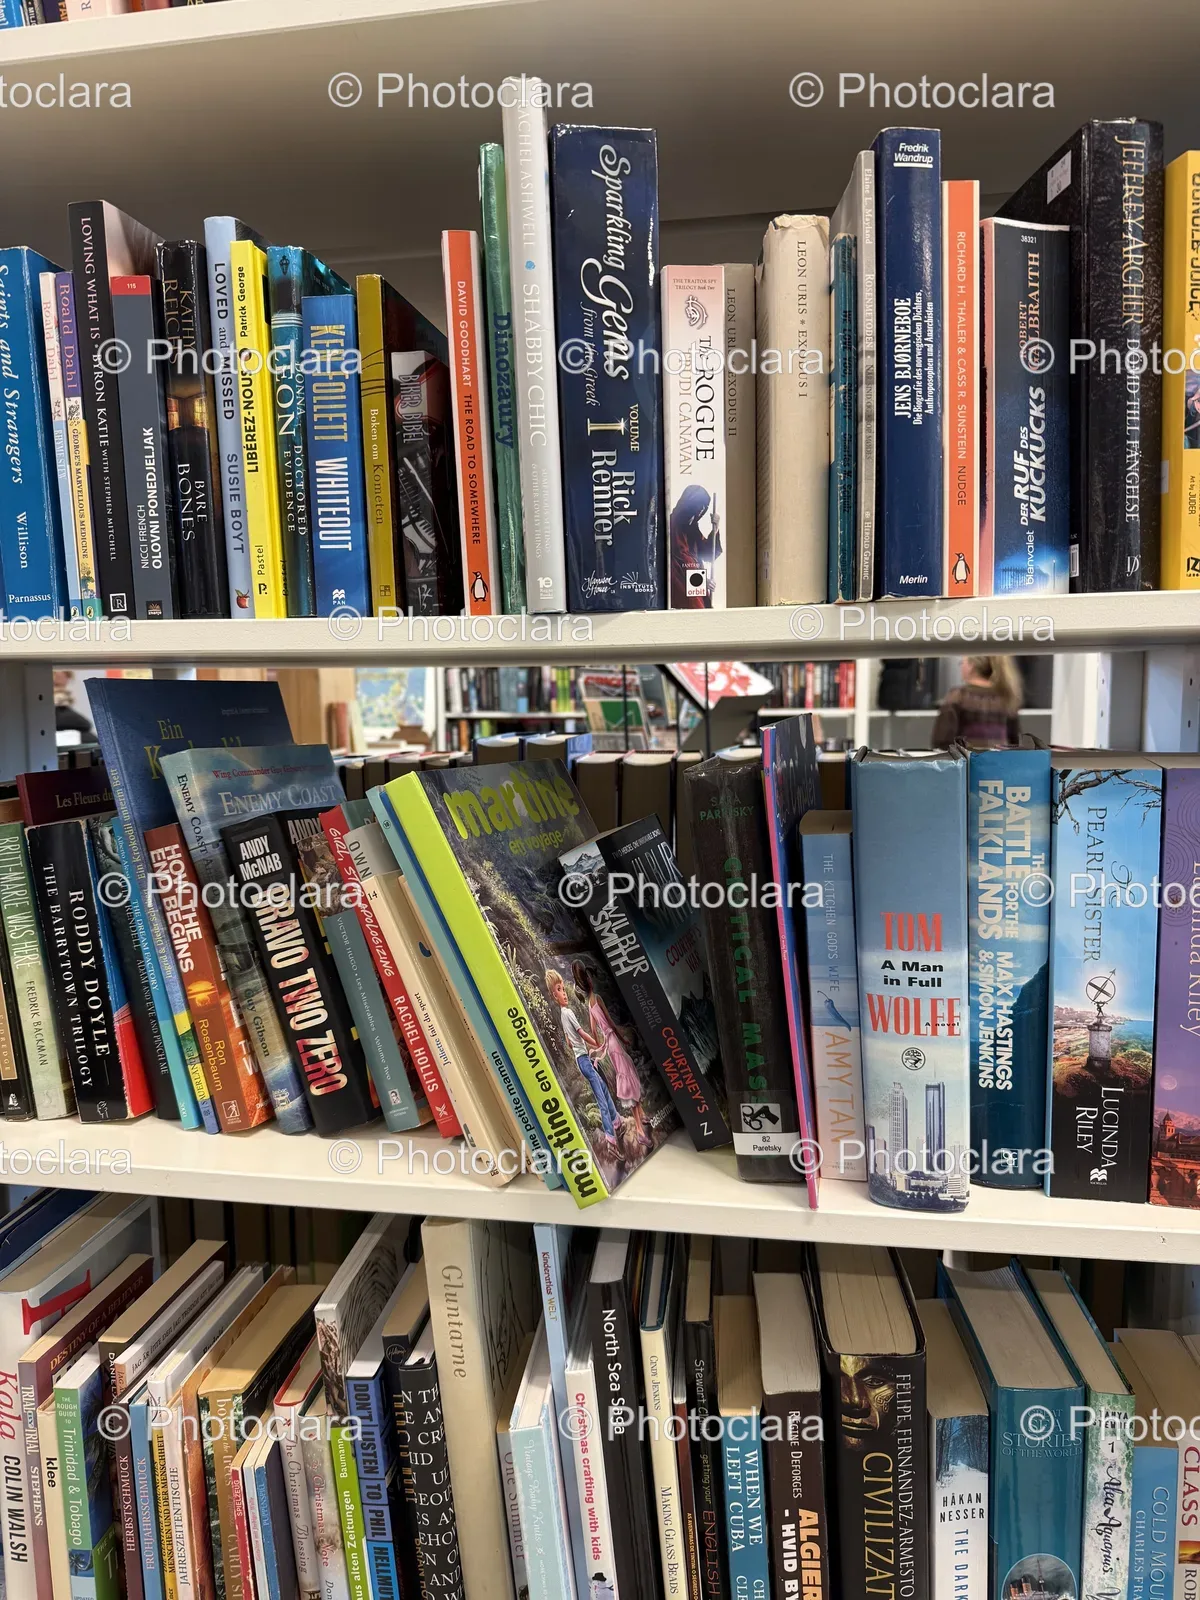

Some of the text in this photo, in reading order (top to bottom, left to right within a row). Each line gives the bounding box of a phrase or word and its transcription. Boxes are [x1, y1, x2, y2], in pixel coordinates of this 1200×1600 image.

[894, 153, 933, 164] Wandrup
[899, 143, 929, 153] Fredrik
[591, 144, 632, 272] Sparkling
[1020, 235, 1037, 243] 38321
[1115, 135, 1148, 328] JEFFREY ARCHER
[127, 282, 136, 290] 115
[214, 263, 229, 320] LOVED
[796, 240, 808, 316] LEON URIS
[59, 283, 77, 388] Roald Dahl
[523, 283, 543, 380] SHABBY
[894, 298, 912, 419] JENS BJØRNEBOE
[956, 231, 967, 505] RICHARD THALER SUNSTEIN NUDGE
[81, 217, 116, 561] LOVING WHAT KATIE MITCHELL
[457, 280, 480, 545] DAVID GOODHART THE ROAD TO SOMEWHERE
[493, 311, 513, 449] Dinozaury
[527, 386, 547, 447] CHIC
[4, 388, 22, 485] Strangers
[629, 403, 640, 452] VOLUME
[679, 402, 693, 476] CANAVAN
[1029, 385, 1045, 522] KUCKUCKS
[142, 427, 162, 569] OLOVNI PONEDJELJAK
[177, 463, 195, 541] BONES
[194, 480, 207, 523] BARE
[227, 453, 244, 553] SUSIE BOYT
[315, 456, 352, 551] WHITEOUT
[592, 449, 617, 547] Renner
[612, 470, 637, 525] Rick
[1013, 450, 1030, 499] RUF
[16, 511, 28, 569] Willison
[137, 504, 147, 543] FRENCH
[257, 545, 265, 576] Pastel
[1025, 530, 1034, 586] blanvalet
[8, 592, 51, 604] Parnassus
[899, 574, 928, 585] Merlin
[157, 718, 184, 741] Ein
[177, 773, 195, 814] ENEMY
[218, 783, 337, 817] ENEMY COAST
[443, 766, 580, 840] martine
[239, 835, 270, 861] ANDY
[239, 852, 283, 882] McNAB
[823, 854, 834, 874] THE
[977, 780, 1004, 941] FALKLANDS
[1005, 786, 1031, 938] BATTLE THE
[162, 895, 194, 974] BEGINS
[880, 911, 944, 953] TOM
[881, 960, 945, 973] A Man
[43, 863, 93, 1088] THE BARRYTOWN TRILOGY
[69, 889, 111, 1057] RODDY DOYLE
[883, 974, 943, 989] in Full
[26, 980, 48, 1066] FREDRIK BACKMAN
[214, 1039, 227, 1066] Ron
[278, 967, 348, 1097] TWO ZERO
[393, 994, 440, 1094] RACHEL HOLLIS
[507, 1007, 541, 1069] voyage
[866, 993, 961, 1038] WOLFE
[978, 963, 994, 1089] SIMON JENKINS
[995, 952, 1013, 1091] MAX HASTINGS
[199, 1018, 223, 1092] Rosenbaum
[661, 1058, 685, 1093] WAR
[662, 1026, 709, 1115] COURTNEY'S
[825, 1031, 857, 1143] AMY TAN
[752, 1144, 782, 1153] Paretsky
[1076, 1106, 1099, 1154] RILEY
[1101, 1086, 1125, 1168] LUCINDA
[441, 1264, 467, 1379] Gluntarne
[541, 1251, 557, 1321] Kinderatlas WELT
[602, 1308, 623, 1392] North Sea
[649, 1355, 659, 1378] CINDY
[56, 1403, 78, 1411] ROUGH
[1002, 1431, 1083, 1448] STORIES
[30, 1466, 43, 1527] STEPHENS
[46, 1456, 58, 1488] klee
[63, 1427, 84, 1546] Trinidad Tobago
[353, 1383, 387, 1538] DON'T LISTEN TO PHIL
[744, 1448, 763, 1546] WHEN WE
[790, 1451, 803, 1498] DEFORGES
[1181, 1446, 1200, 1527] CLASS
[3, 1455, 28, 1563] COLIN WALSH
[120, 1455, 136, 1552] HERBSTSCHMUCK
[137, 1457, 155, 1570] FRÜHJAHRSSCHMUCK
[169, 1466, 190, 1586] JAHRESZEITENTISCHE
[343, 1490, 357, 1549] Zeitungen
[582, 1457, 601, 1561] crafting with kids
[700, 1454, 720, 1596] getting ENGLISH
[726, 1446, 745, 1552] LEFT CUBA
[896, 1429, 917, 1599] FERNÁNDEZ-ARMESTO
[940, 1508, 985, 1523] NESSER
[942, 1491, 982, 1507] HÅKAN
[1151, 1486, 1170, 1543] COLD
[660, 1487, 680, 1595] MAKING GLASS BEADS
[782, 1524, 798, 1573] HVID
[954, 1529, 969, 1556] THE
